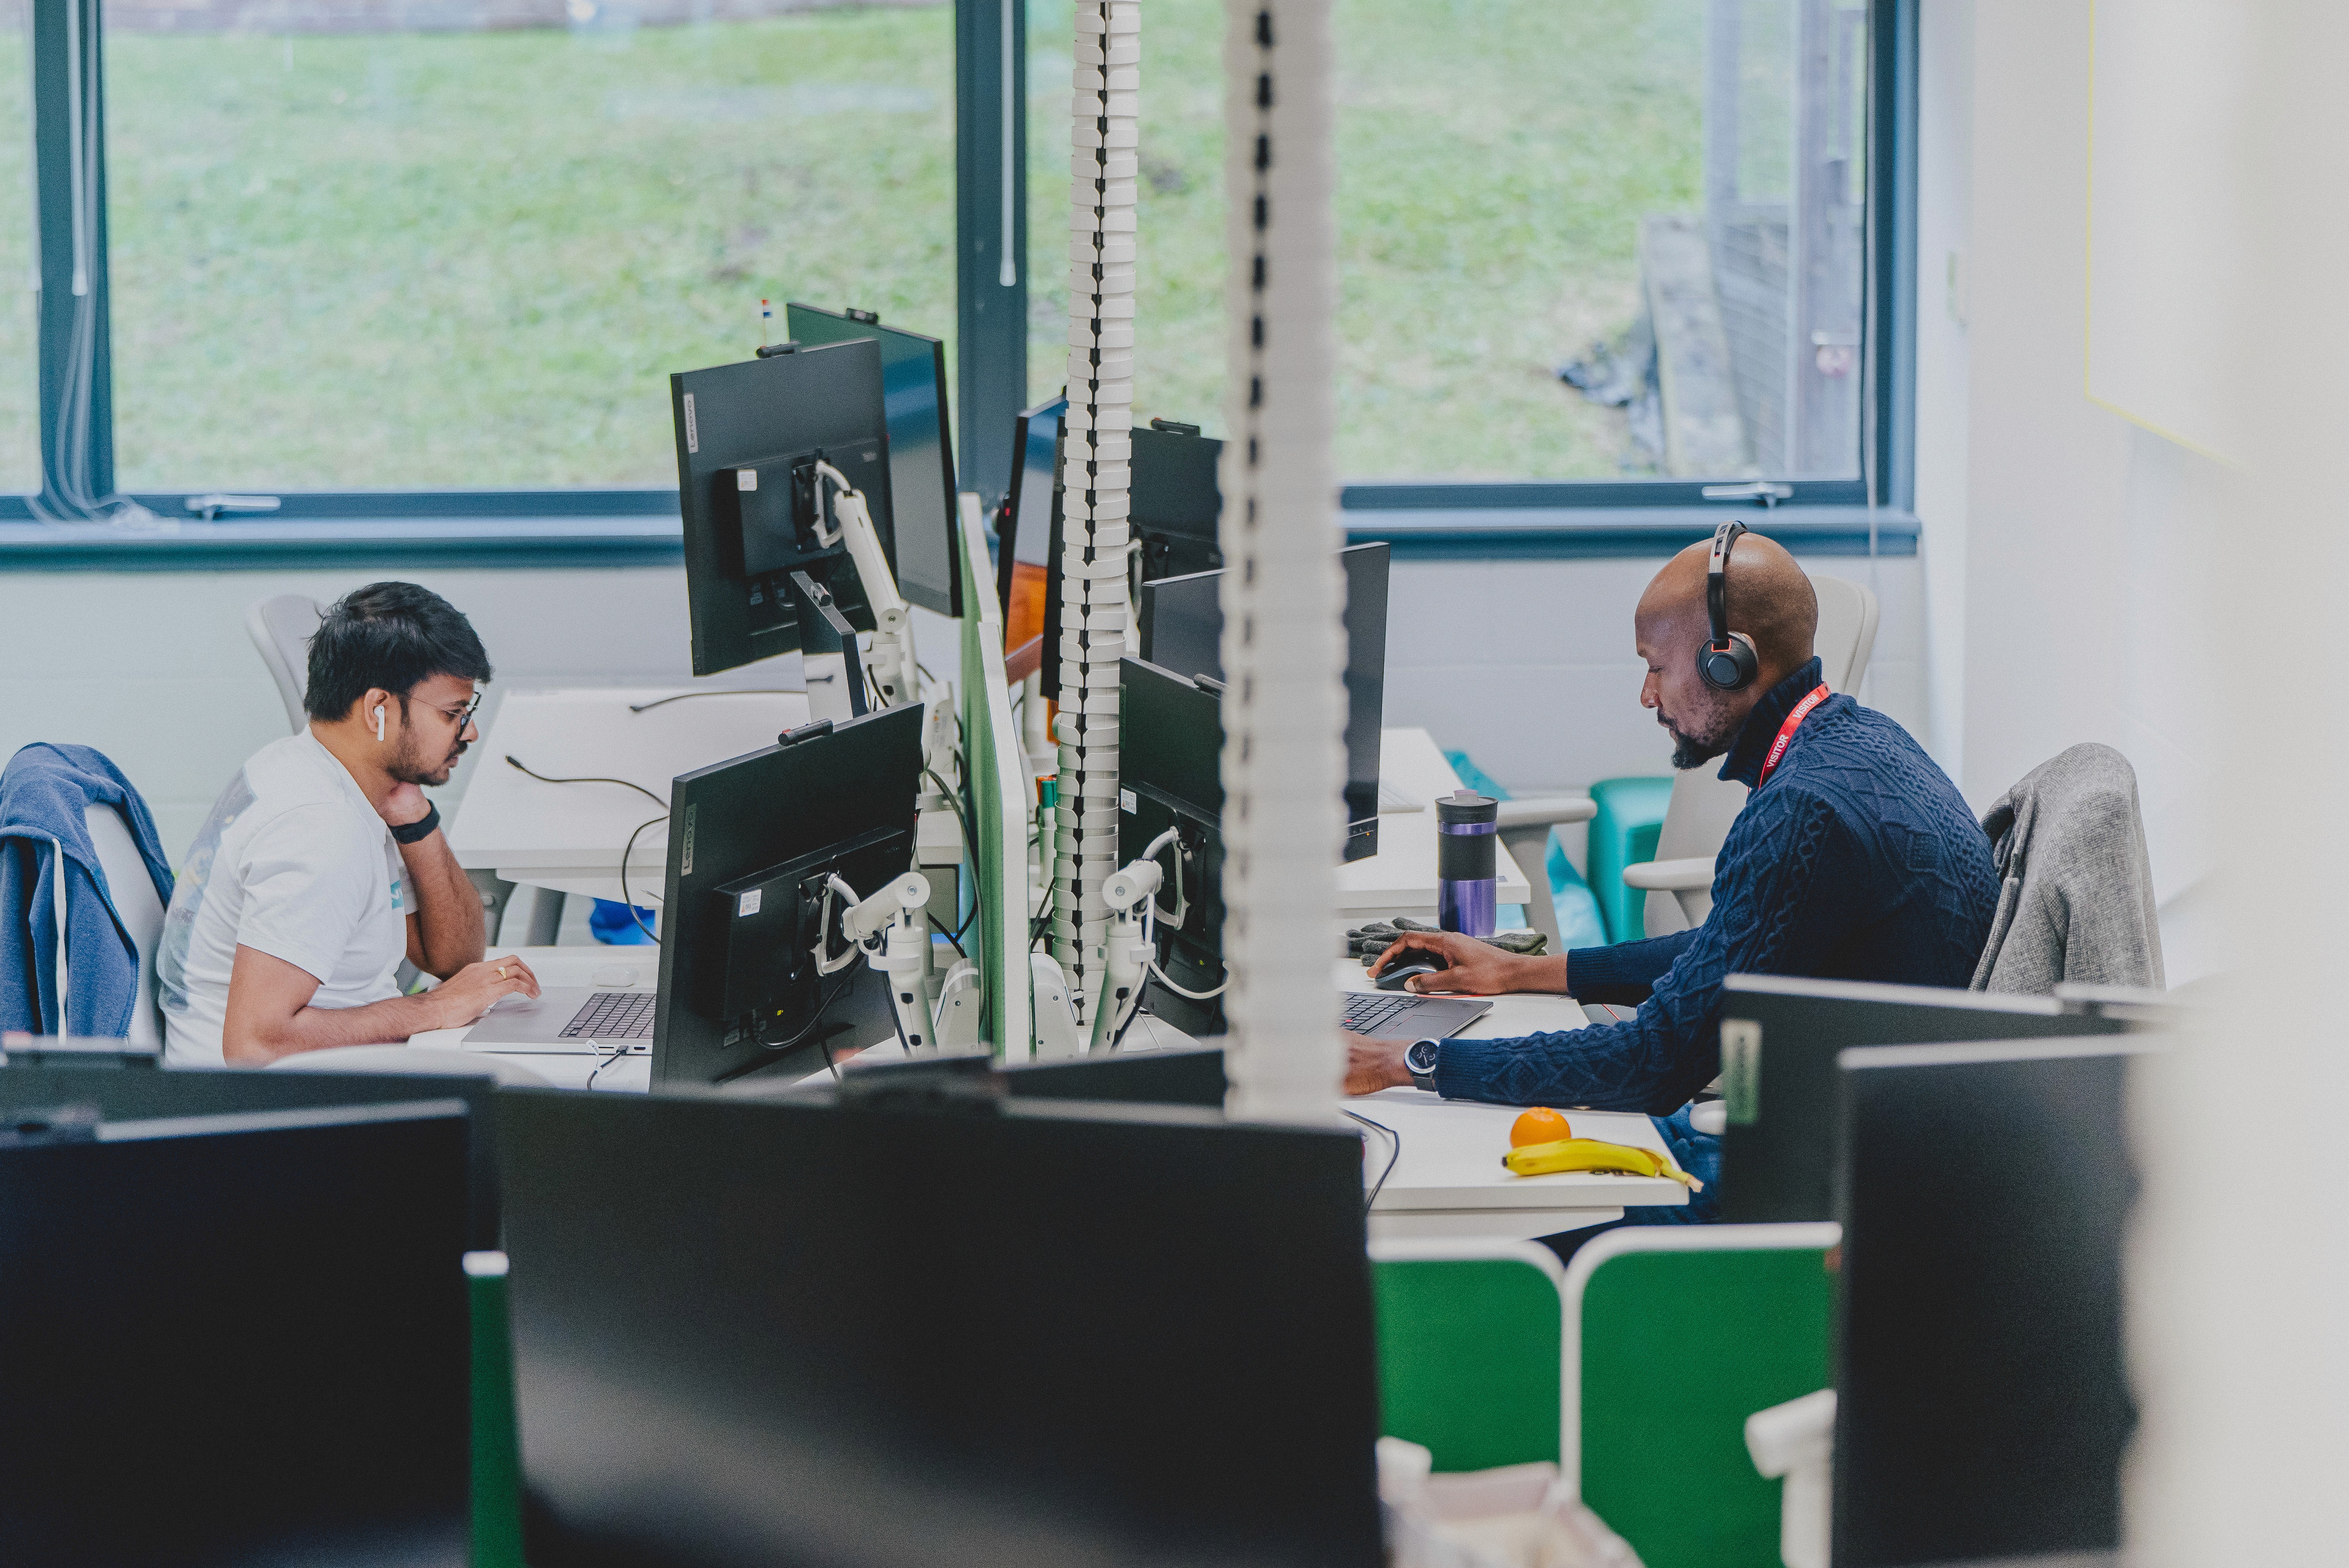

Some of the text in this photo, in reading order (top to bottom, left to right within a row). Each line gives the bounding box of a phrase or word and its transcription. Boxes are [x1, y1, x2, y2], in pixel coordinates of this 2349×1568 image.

[1792, 694, 1819, 719] VISITOR
[1766, 734, 1789, 768] VISITOR
[684, 812, 693, 869] Lenovo
